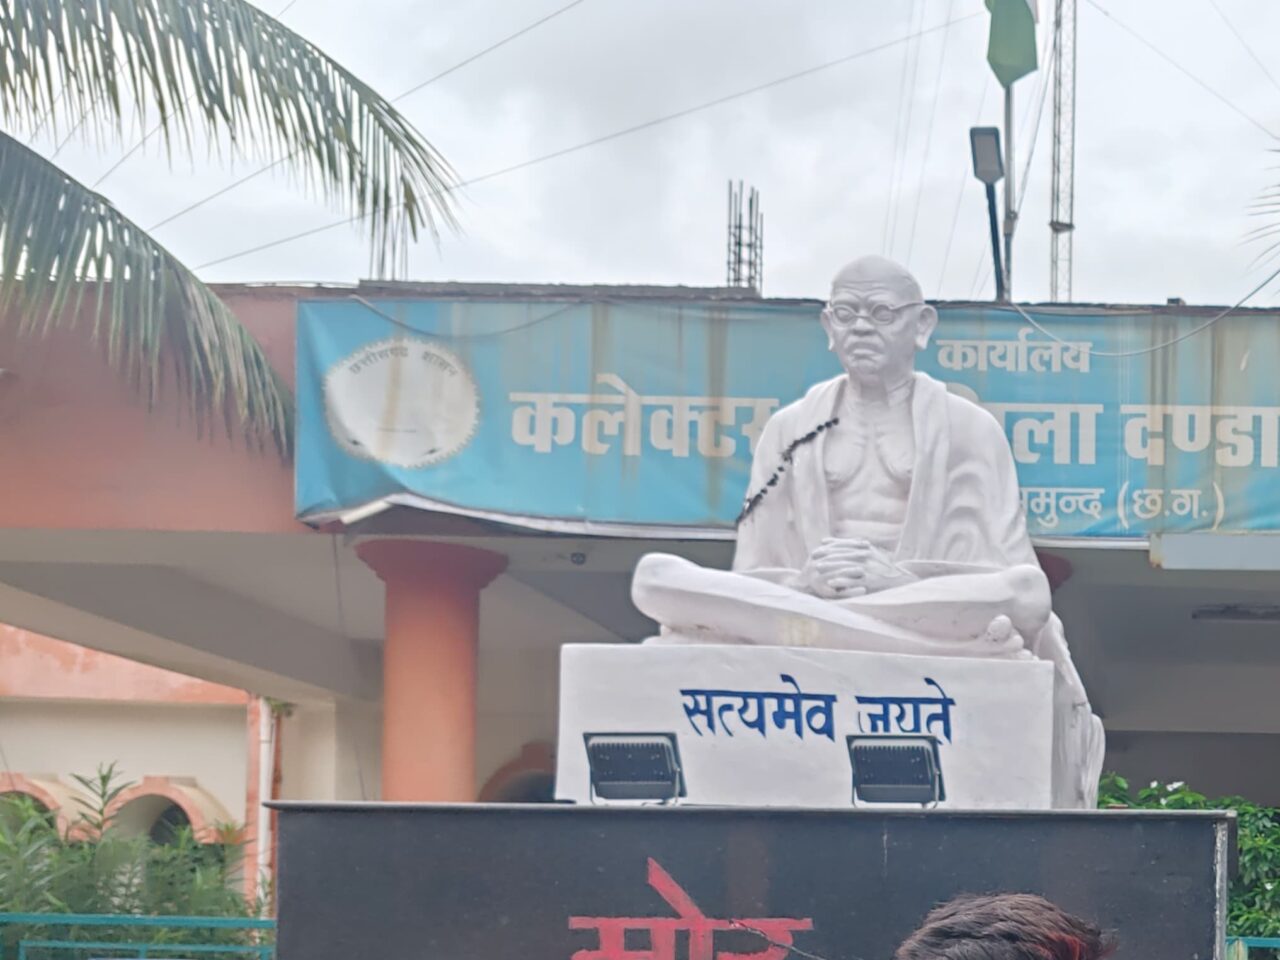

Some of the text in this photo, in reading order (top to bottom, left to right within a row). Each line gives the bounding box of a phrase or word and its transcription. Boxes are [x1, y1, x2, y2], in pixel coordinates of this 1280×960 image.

[937, 328, 1091, 373] कार्यालय
[1117, 481, 1224, 531] (छ.ग.)
[680, 674, 957, 746] सत्यमेव जयते
